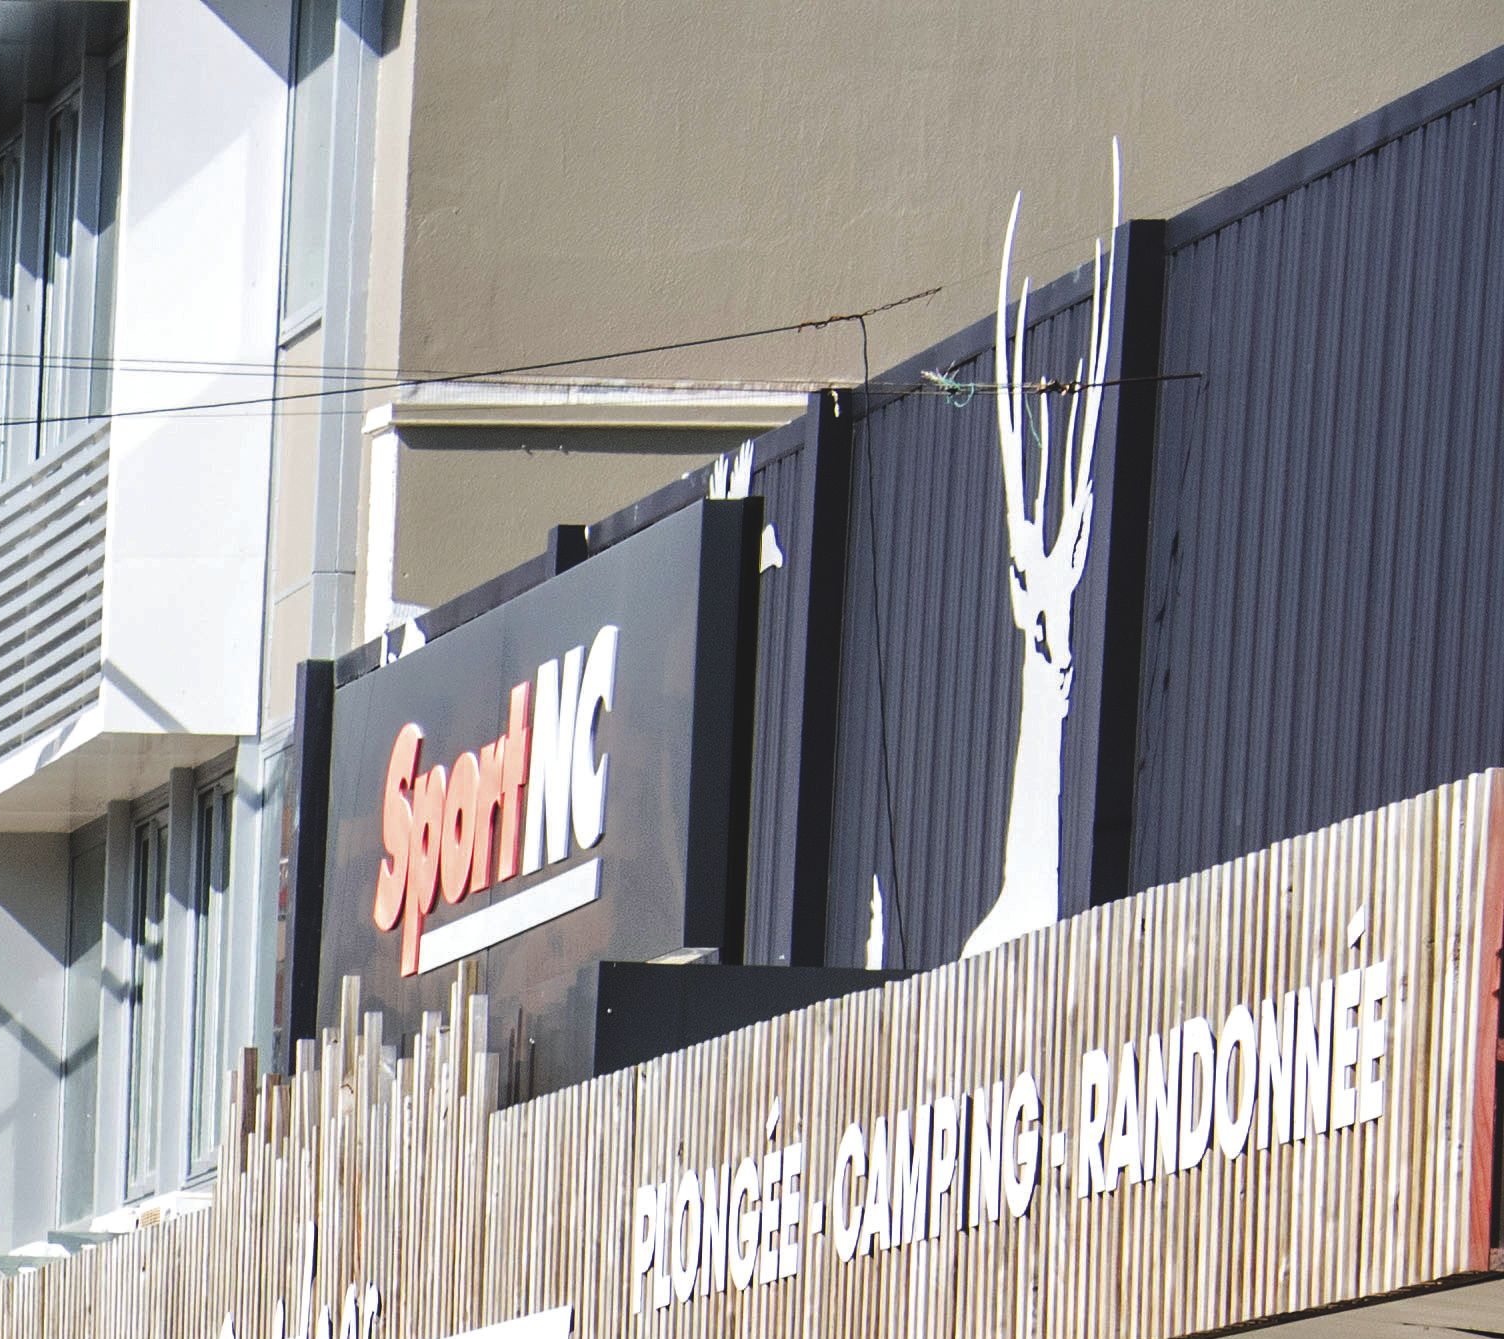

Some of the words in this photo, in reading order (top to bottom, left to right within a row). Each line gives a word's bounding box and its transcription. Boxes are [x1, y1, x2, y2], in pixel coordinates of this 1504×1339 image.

[374, 682, 531, 977] Sport
[632, 1097, 801, 1314] PLONGÉE
[833, 1072, 1043, 1262] CAMPING
[1080, 906, 1388, 1199] RANDONNÉE
